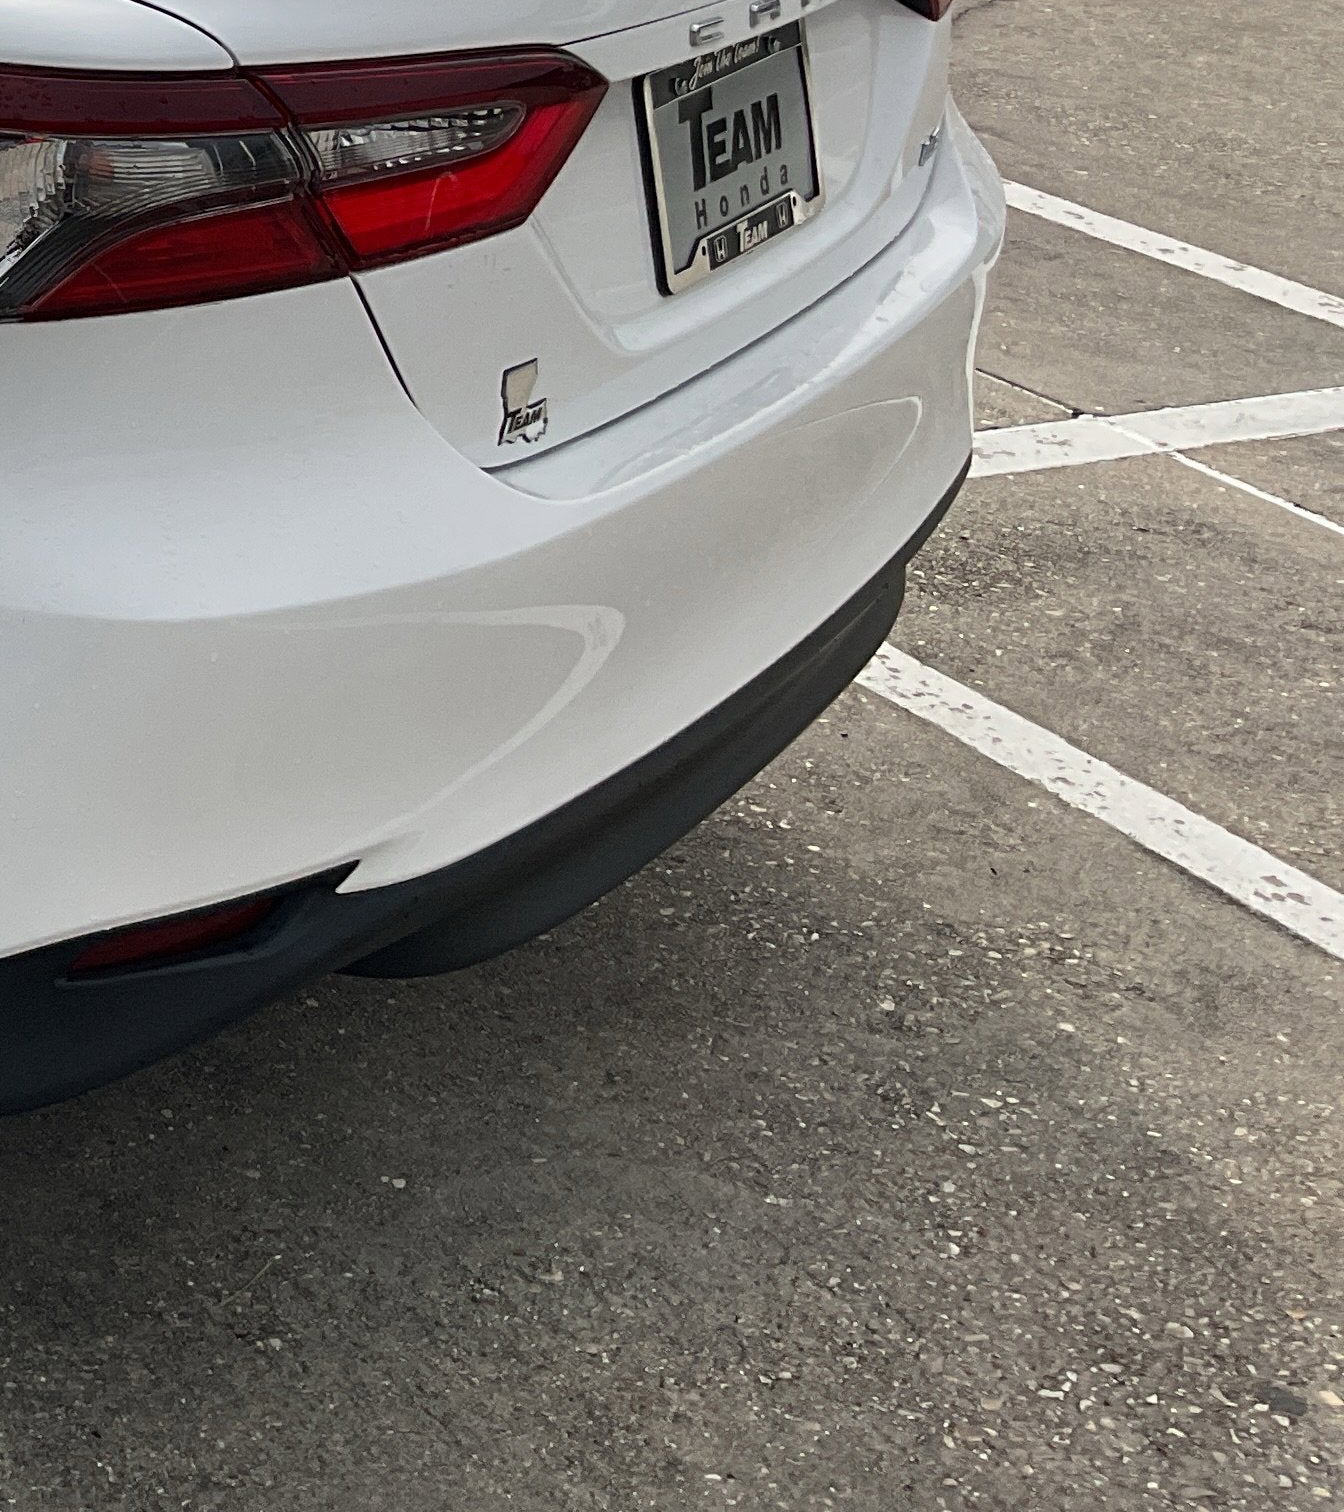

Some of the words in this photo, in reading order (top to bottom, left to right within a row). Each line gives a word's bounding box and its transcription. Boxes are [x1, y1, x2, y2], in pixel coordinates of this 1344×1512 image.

[678, 86, 782, 192] TEAM
[694, 164, 789, 230] Honda
[736, 219, 769, 252] TEAM
